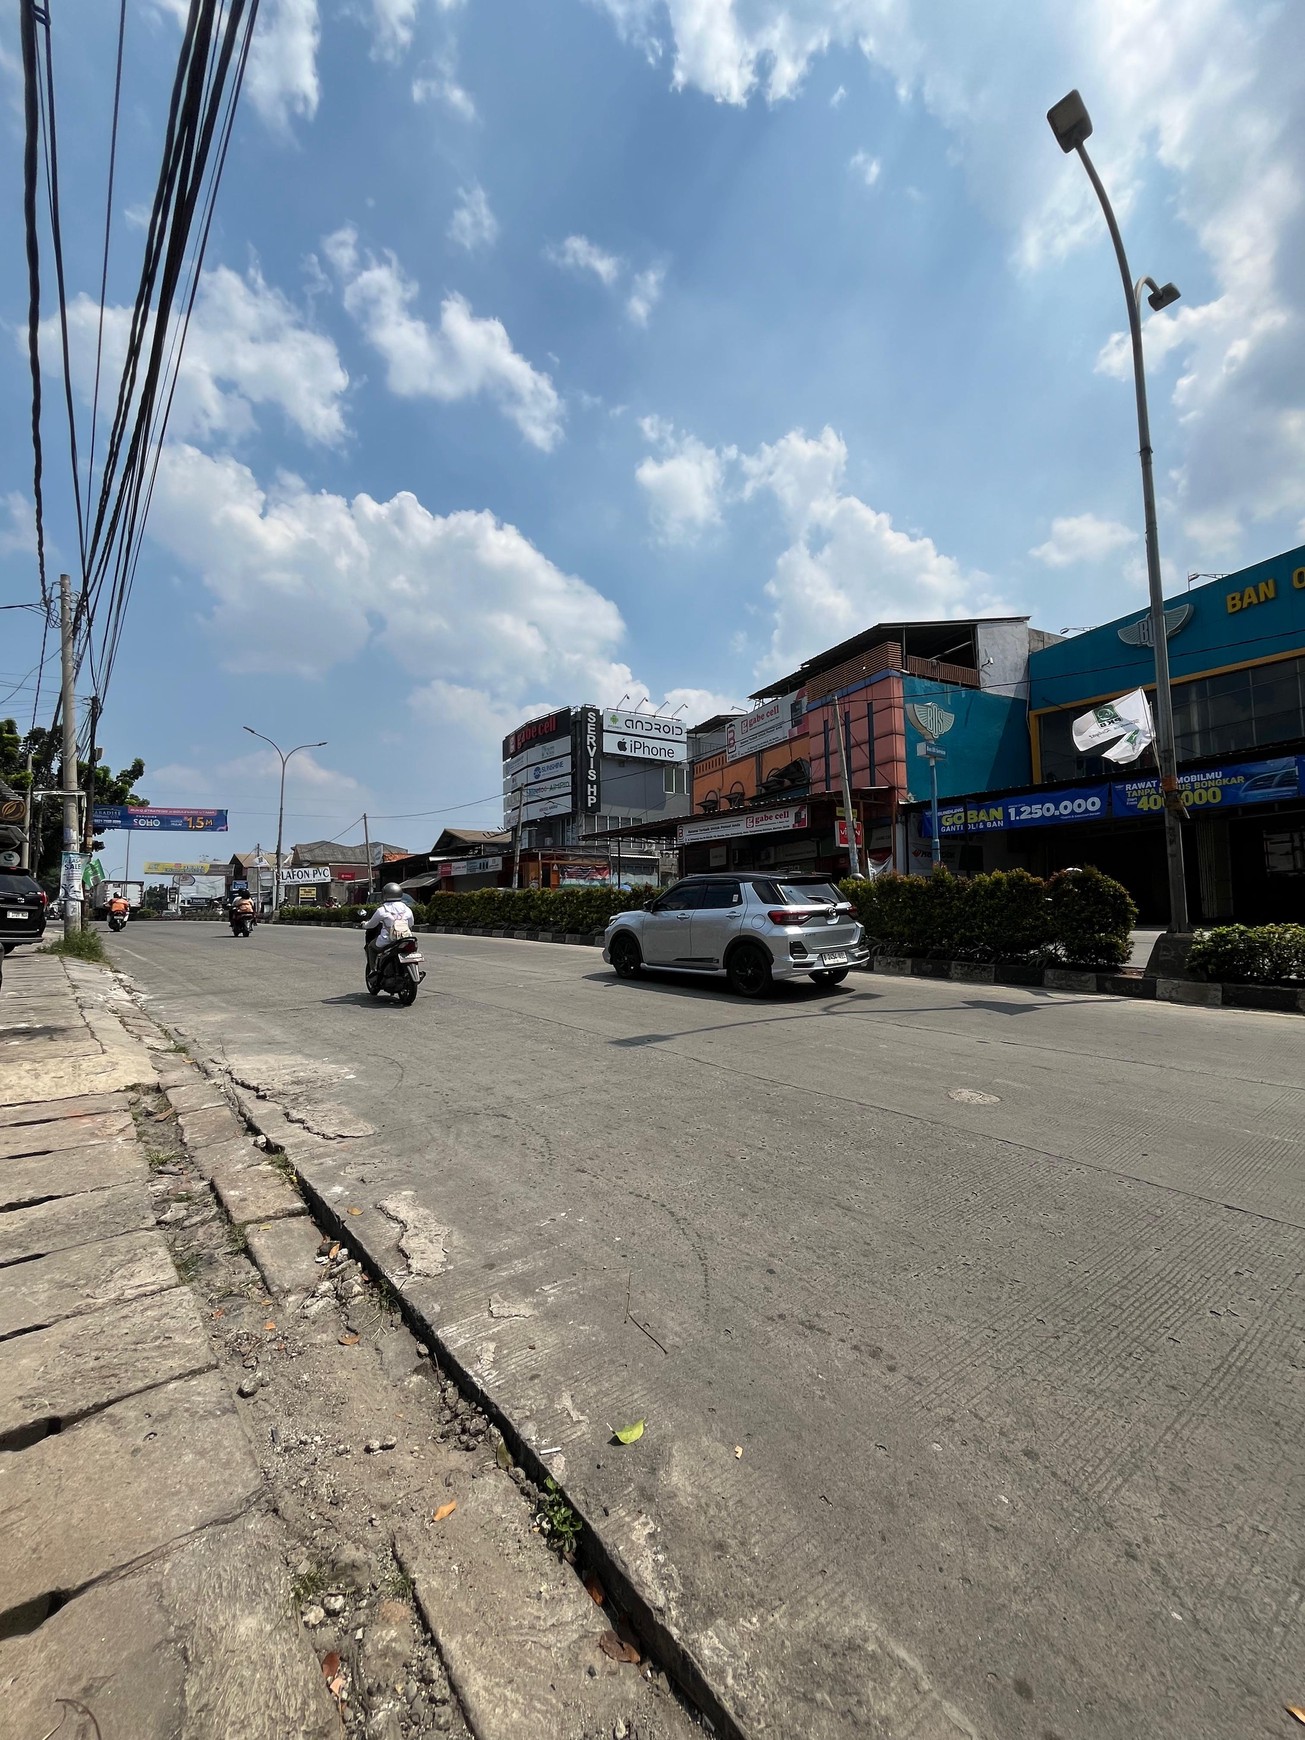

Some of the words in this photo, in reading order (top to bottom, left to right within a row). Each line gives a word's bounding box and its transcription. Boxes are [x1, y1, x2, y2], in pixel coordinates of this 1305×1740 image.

[1226, 578, 1276, 614] BAN
[538, 716, 557, 735] cell
[748, 713, 765, 728] gabe
[766, 704, 780, 717] cell
[927, 705, 944, 736] BOS
[587, 711, 597, 780] SERVIS
[630, 740, 675, 758] iPhone
[1125, 780, 1157, 791] RAWAT
[1176, 771, 1222, 783] MOBILMU
[1126, 787, 1157, 797] TANPA
[1194, 776, 1245, 789] BONGKAR
[587, 783, 597, 807] HP
[755, 814, 774, 825] gabe
[774, 811, 789, 820] cell
[1008, 797, 1101, 821] 1.250.000
[133, 818, 160, 827] SOHO
[941, 824, 963, 833] GANTI
[986, 820, 1004, 828] BAN
[281, 869, 310, 881] LAFON
[312, 868, 329, 878] PVC
